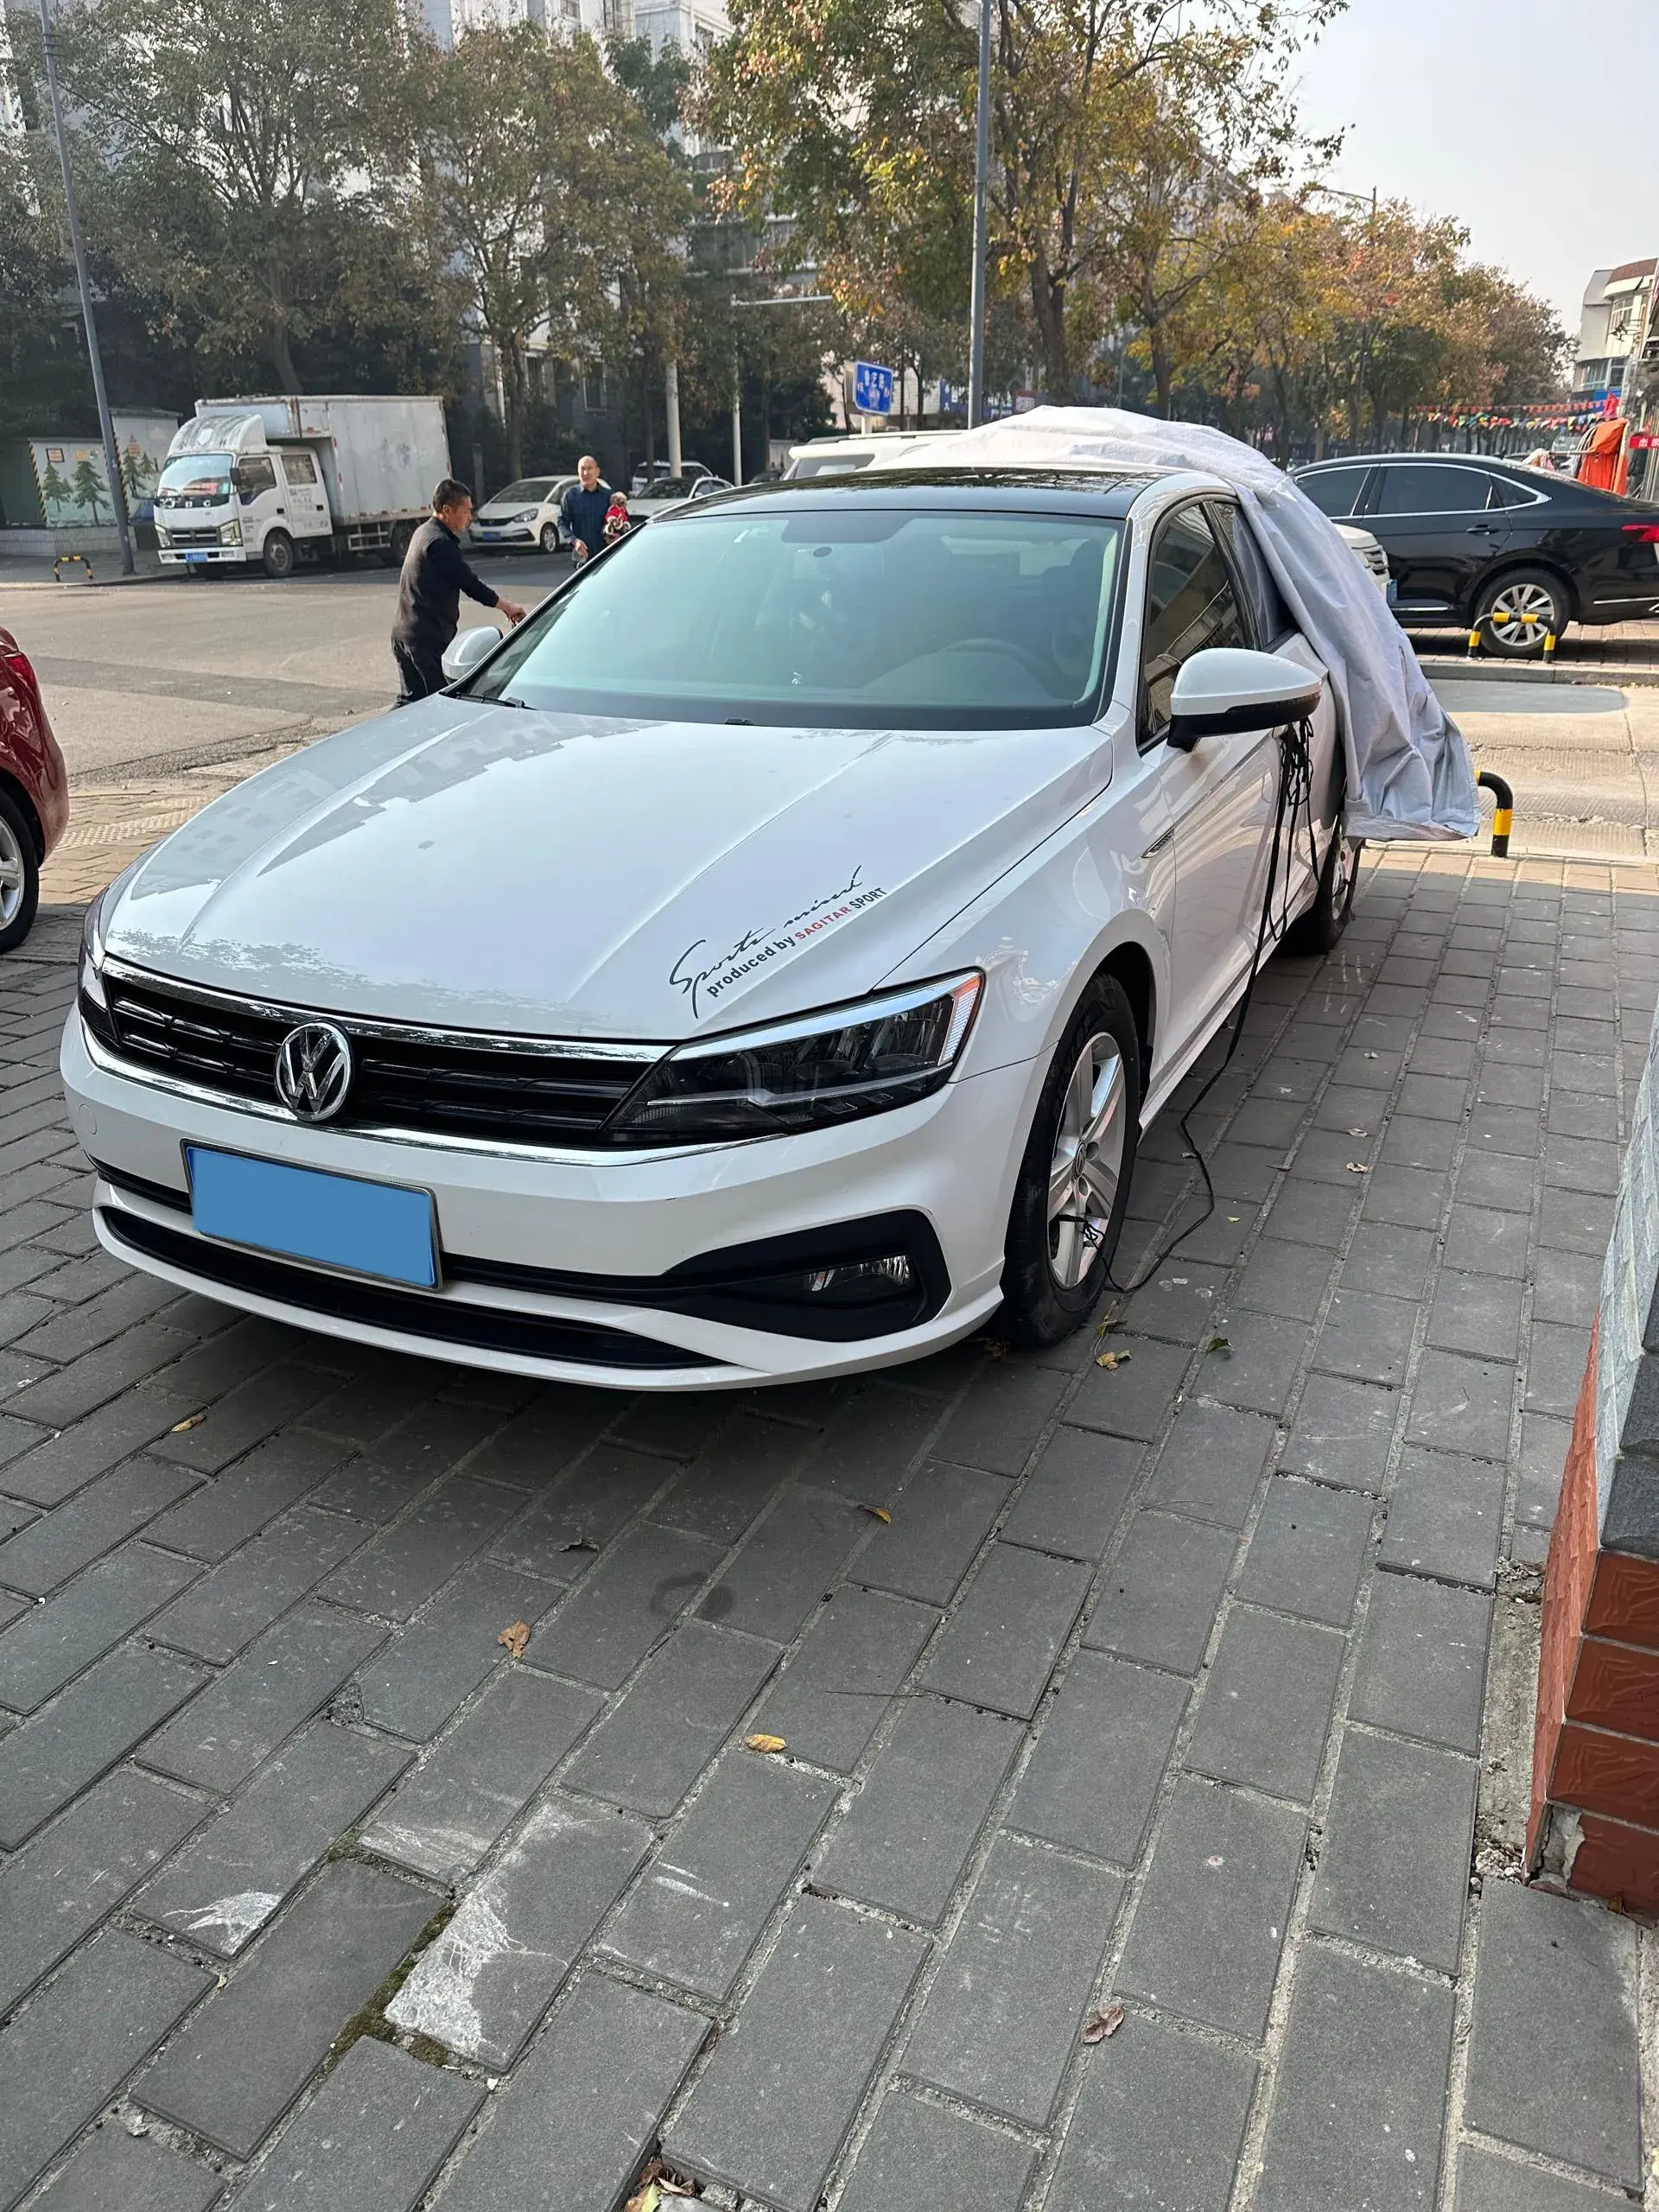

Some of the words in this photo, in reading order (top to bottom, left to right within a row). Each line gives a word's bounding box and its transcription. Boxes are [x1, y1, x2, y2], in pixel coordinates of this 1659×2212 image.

[783, 865, 862, 928] mind
[706, 945, 777, 997] produced
[773, 936, 796, 951] by
[795, 906, 851, 940] SAGITAR
[849, 887, 887, 909] SPORT
